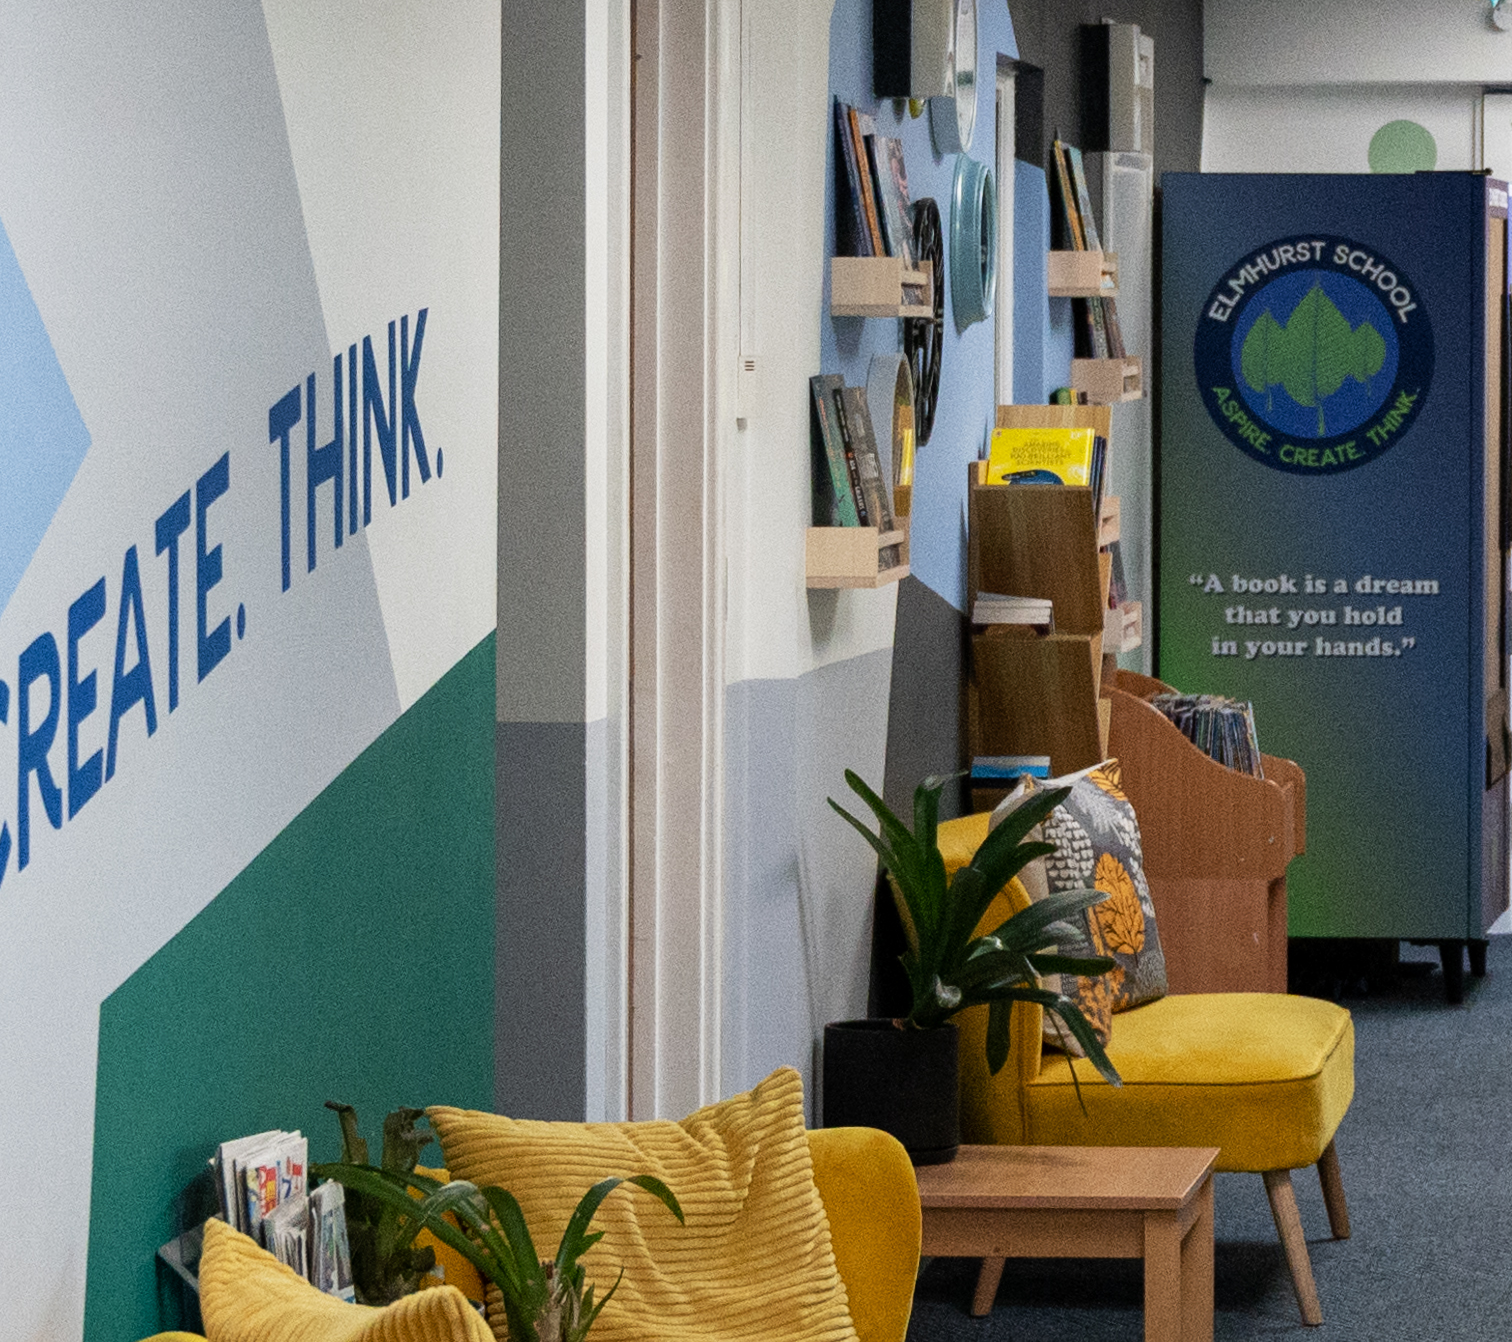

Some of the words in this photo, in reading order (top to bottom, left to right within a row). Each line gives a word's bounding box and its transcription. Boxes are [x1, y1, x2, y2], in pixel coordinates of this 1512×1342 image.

[1208, 240, 1326, 323] ELMHURST
[1333, 243, 1418, 324] SCHOOL
[268, 307, 445, 594] THINK.
[1212, 386, 1272, 455] ASPIRE.
[1279, 440, 1367, 468] CREATE.
[1366, 387, 1421, 446] THINK.
[1232, 574, 1298, 594] book
[1304, 574, 1327, 594] is
[1333, 579, 1348, 594] a
[1354, 574, 1439, 594] dream
[1224, 605, 1282, 625] that
[1287, 609, 1337, 629] you
[1343, 605, 1404, 625] hold
[1211, 635, 1239, 656] in
[1245, 640, 1308, 659] your
[1315, 635, 1417, 657] hands.”
